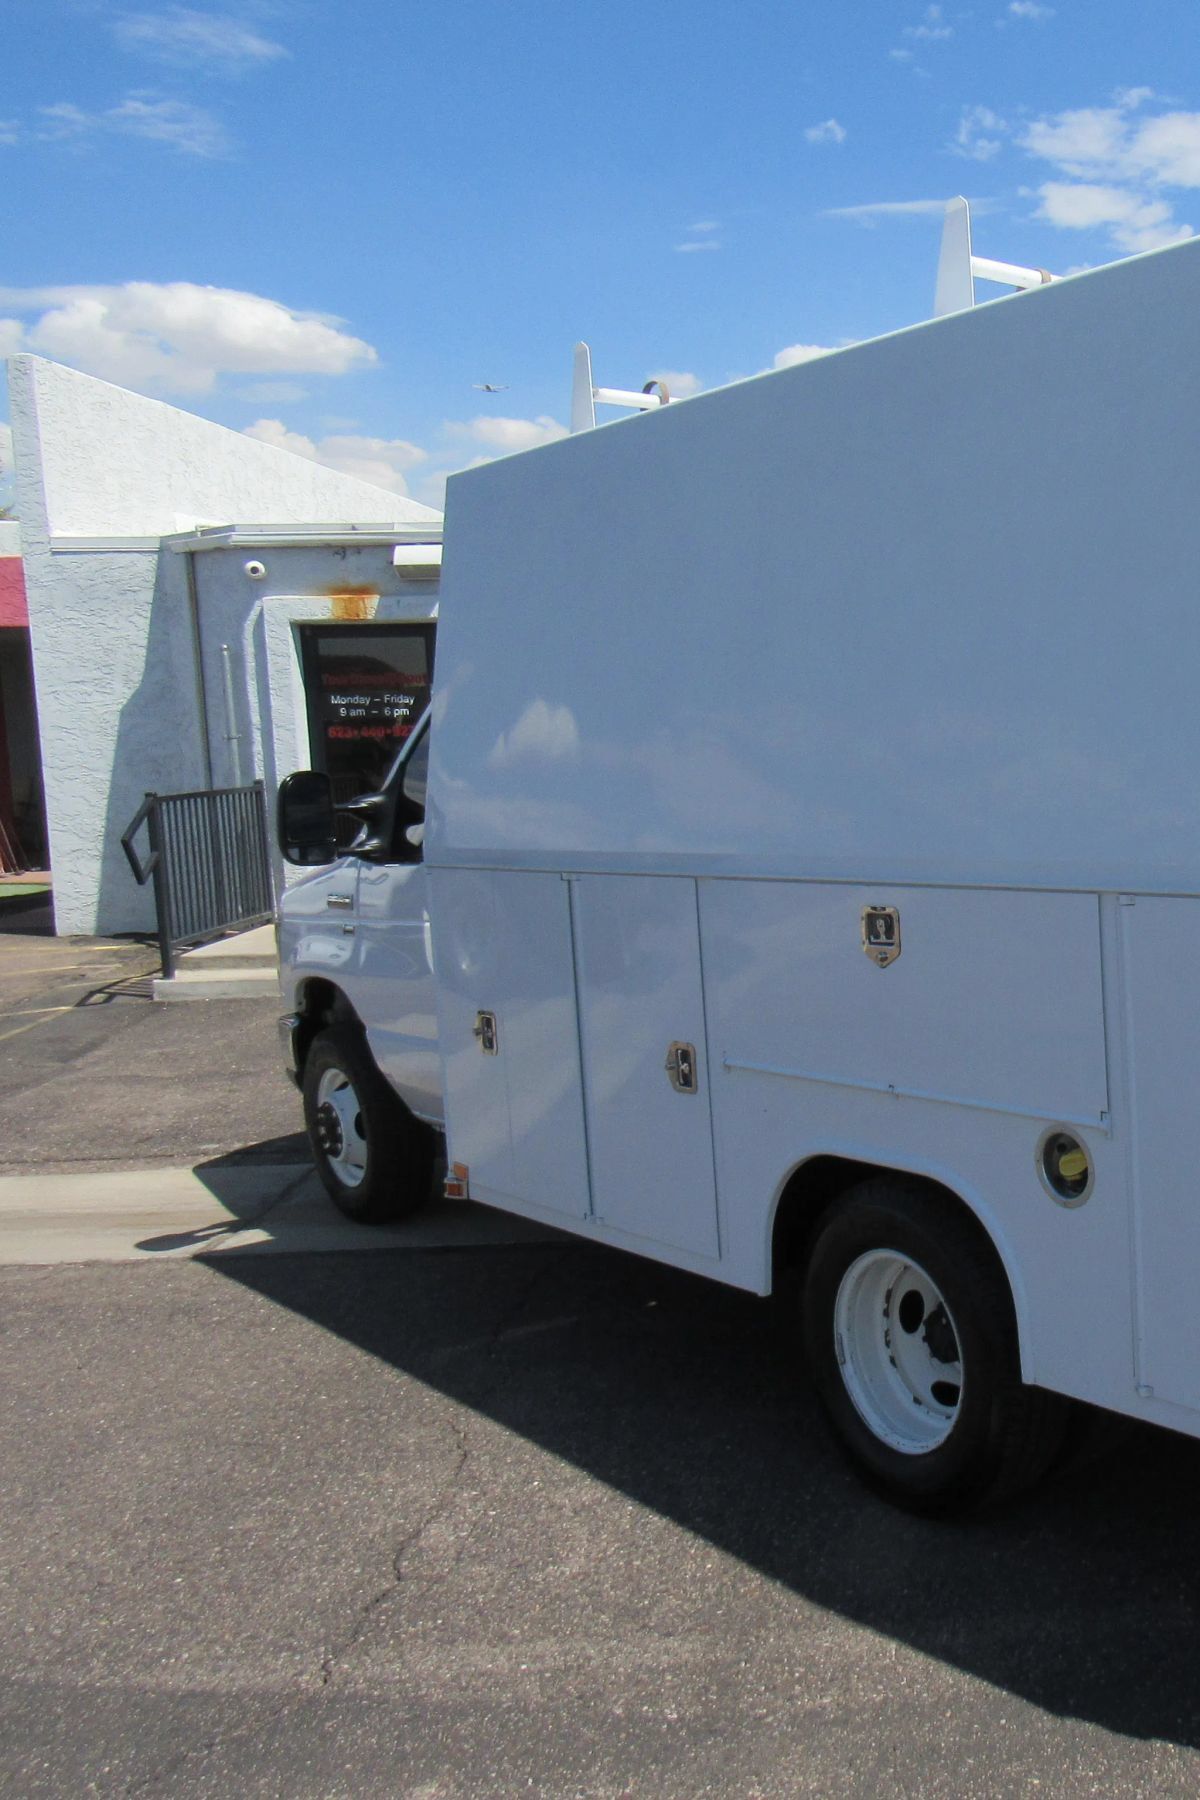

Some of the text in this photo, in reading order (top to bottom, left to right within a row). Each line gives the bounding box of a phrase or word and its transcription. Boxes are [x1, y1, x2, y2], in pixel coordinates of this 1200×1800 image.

[330, 694, 371, 706] Monday
[384, 694, 416, 706] Friday
[340, 707, 347, 717] 9
[349, 709, 366, 717] am
[384, 707, 392, 716] 6
[393, 708, 410, 718] pm
